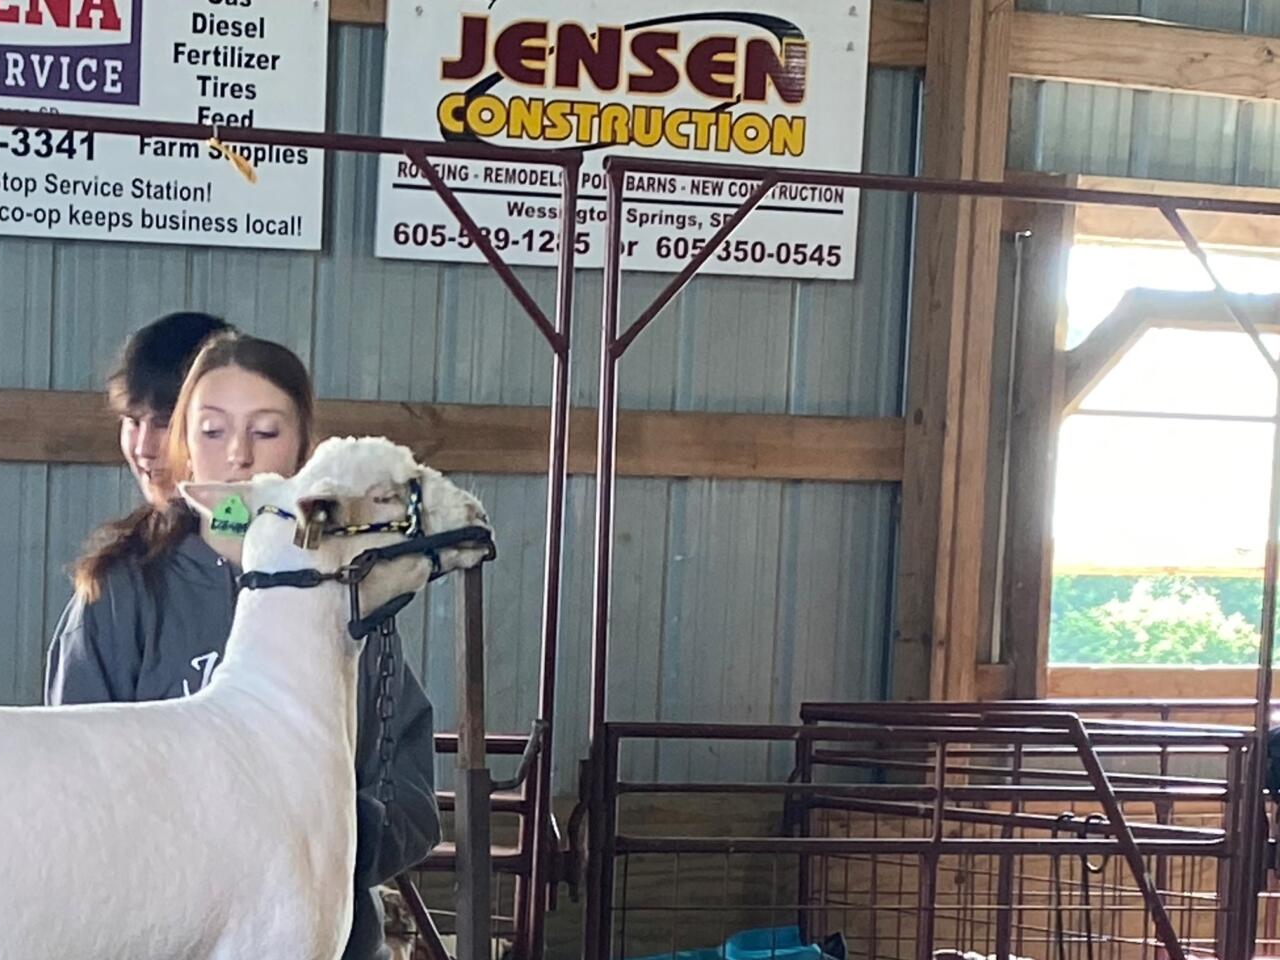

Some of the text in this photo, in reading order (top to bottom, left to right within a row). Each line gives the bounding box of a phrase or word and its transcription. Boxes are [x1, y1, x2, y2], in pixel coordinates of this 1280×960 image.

[192, 12, 265, 39] Diesel
[173, 42, 280, 71] Fertilizer
[441, 12, 808, 105] JENSEN
[196, 75, 257, 100] Tires
[198, 106, 254, 128] Feed
[437, 92, 807, 158] CONSTRUCTION
[139, 136, 200, 158] Farm
[44, 173, 124, 198] Service
[131, 178, 212, 203] Station!
[398, 161, 469, 181] ROFING
[483, 166, 563, 187] REMODEL
[625, 175, 677, 193] BARNS
[690, 179, 724, 196] NEW
[728, 181, 844, 204] CONTRUCTION
[69, 205, 133, 233] keeps
[141, 208, 238, 234] business
[246, 213, 303, 237] local!
[507, 201, 608, 224] Wessgto
[626, 208, 703, 231] Springs,
[393, 222, 590, 255] 605-59-125
[656, 236, 842, 267] 605350-0545
